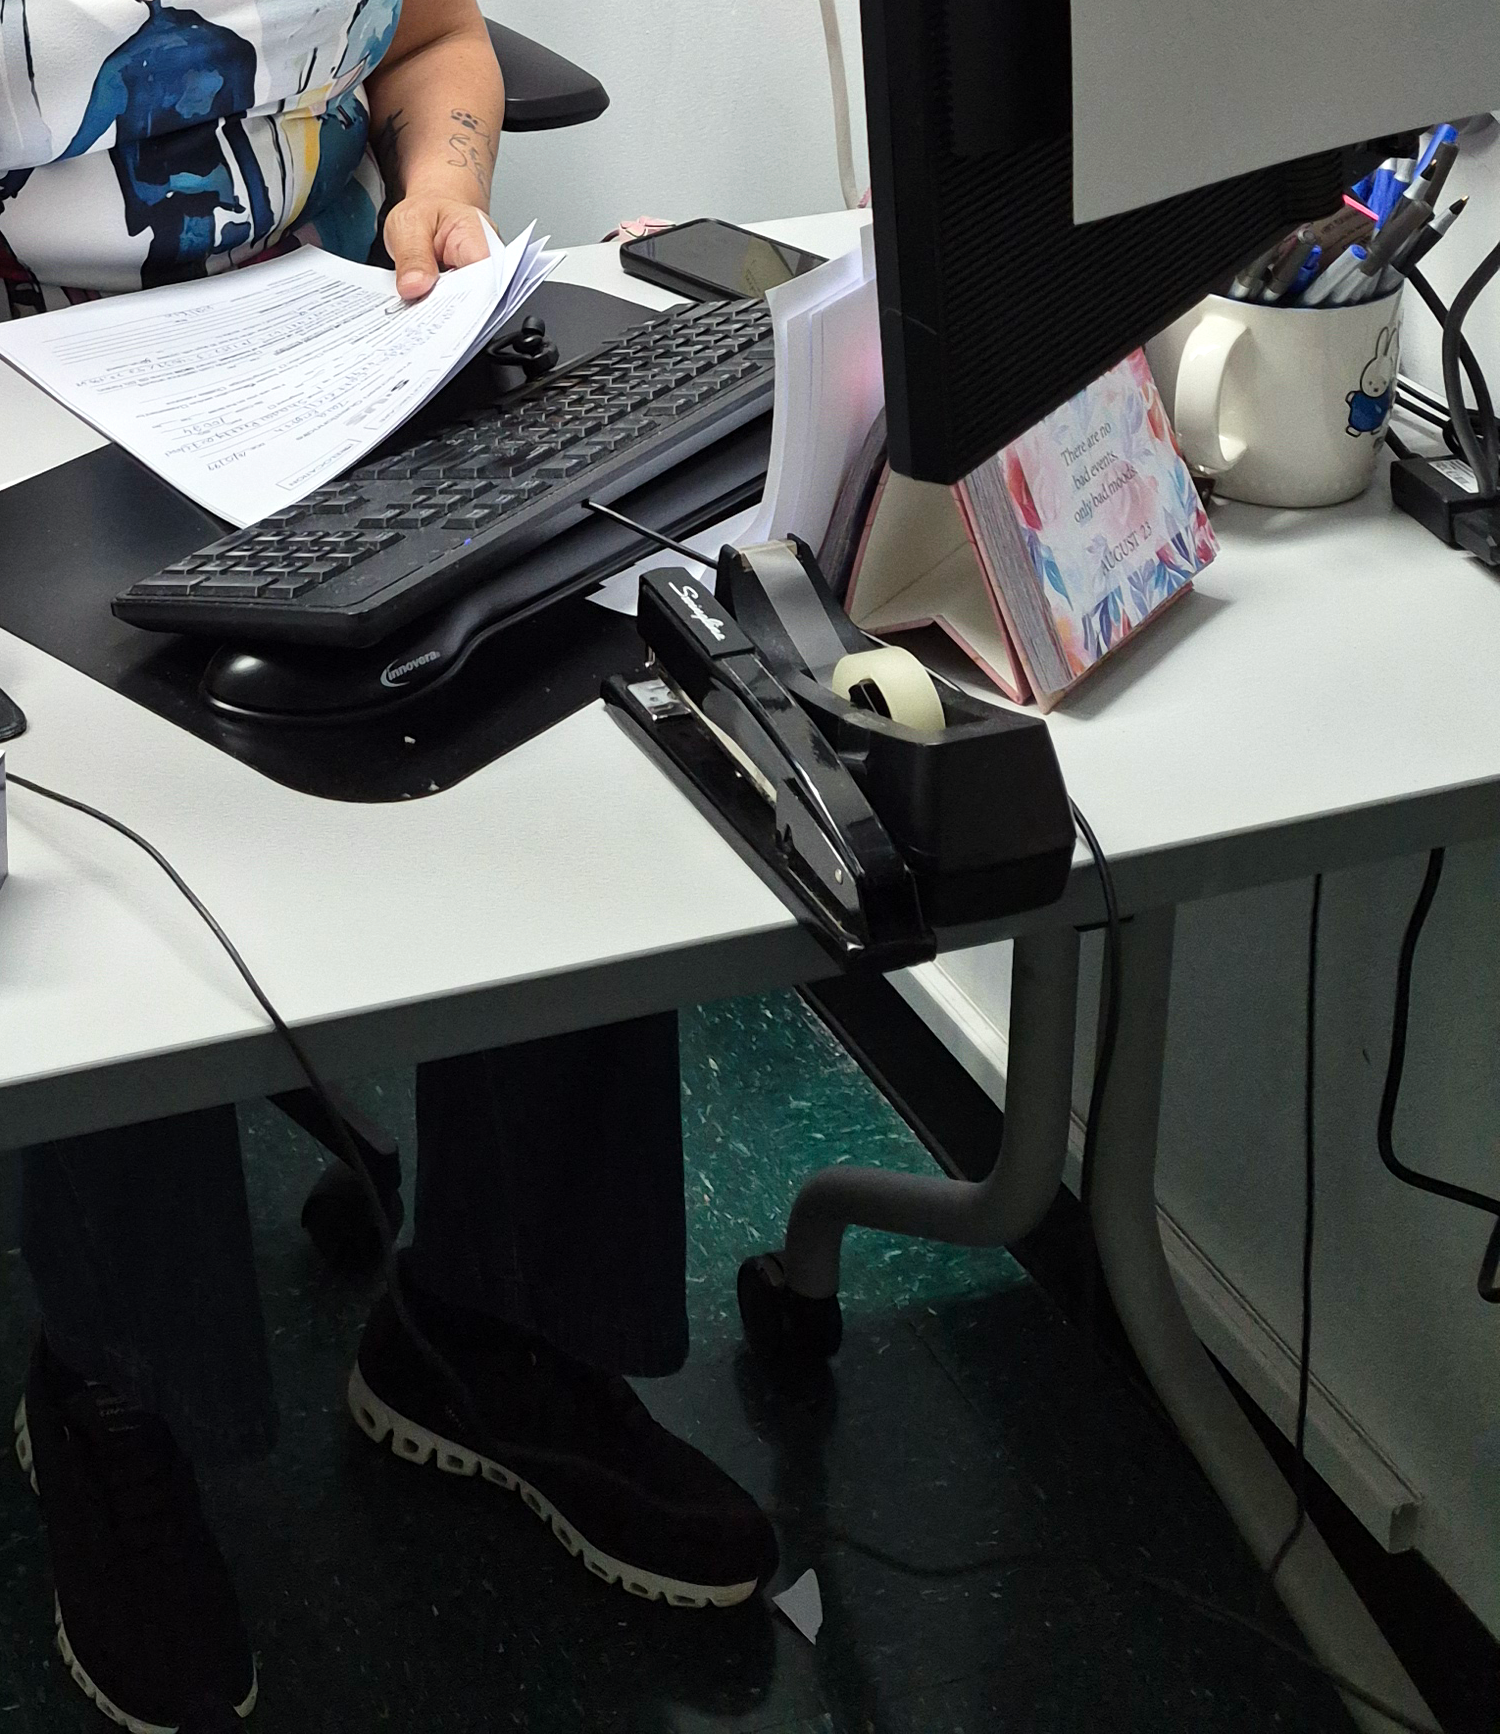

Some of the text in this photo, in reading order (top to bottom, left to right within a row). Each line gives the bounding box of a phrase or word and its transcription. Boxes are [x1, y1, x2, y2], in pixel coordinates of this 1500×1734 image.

[1061, 422, 1112, 467] There are no
[1072, 466, 1091, 490] bad
[1074, 498, 1092, 523] only
[1092, 487, 1109, 508] bad
[1101, 521, 1152, 576] AUGUST 23
[388, 651, 437, 681] innovera
